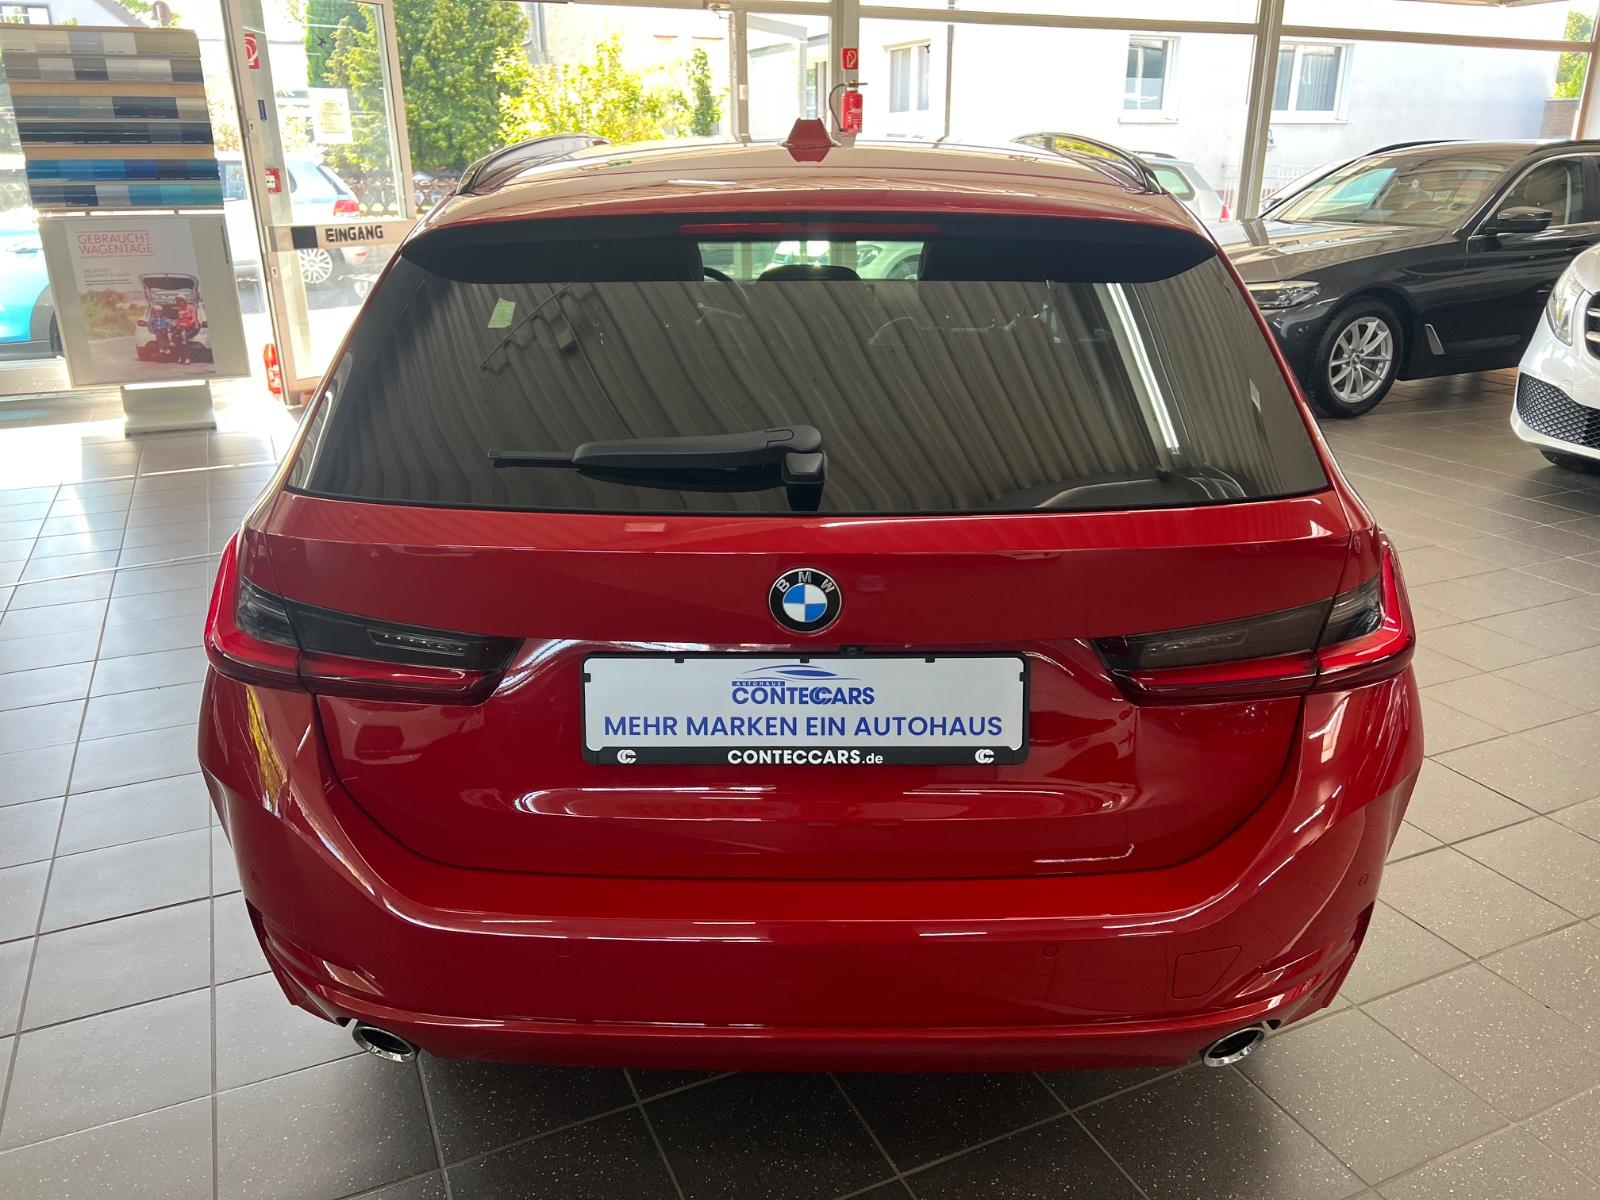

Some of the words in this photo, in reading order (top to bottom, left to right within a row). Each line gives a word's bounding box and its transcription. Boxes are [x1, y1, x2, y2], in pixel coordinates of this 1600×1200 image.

[77, 233, 150, 244] GEBRAUCHT
[325, 225, 384, 242] EINGANG
[79, 244, 153, 255] WAGENTAGE
[776, 571, 835, 593] BMW
[731, 686, 875, 705] CONTECCARS
[604, 716, 678, 736] MEHR
[686, 716, 797, 736] MARKEN
[806, 716, 845, 736] EIN
[854, 716, 1003, 736] AUTOHAUS
[727, 749, 883, 765] CONTECCARS.de
